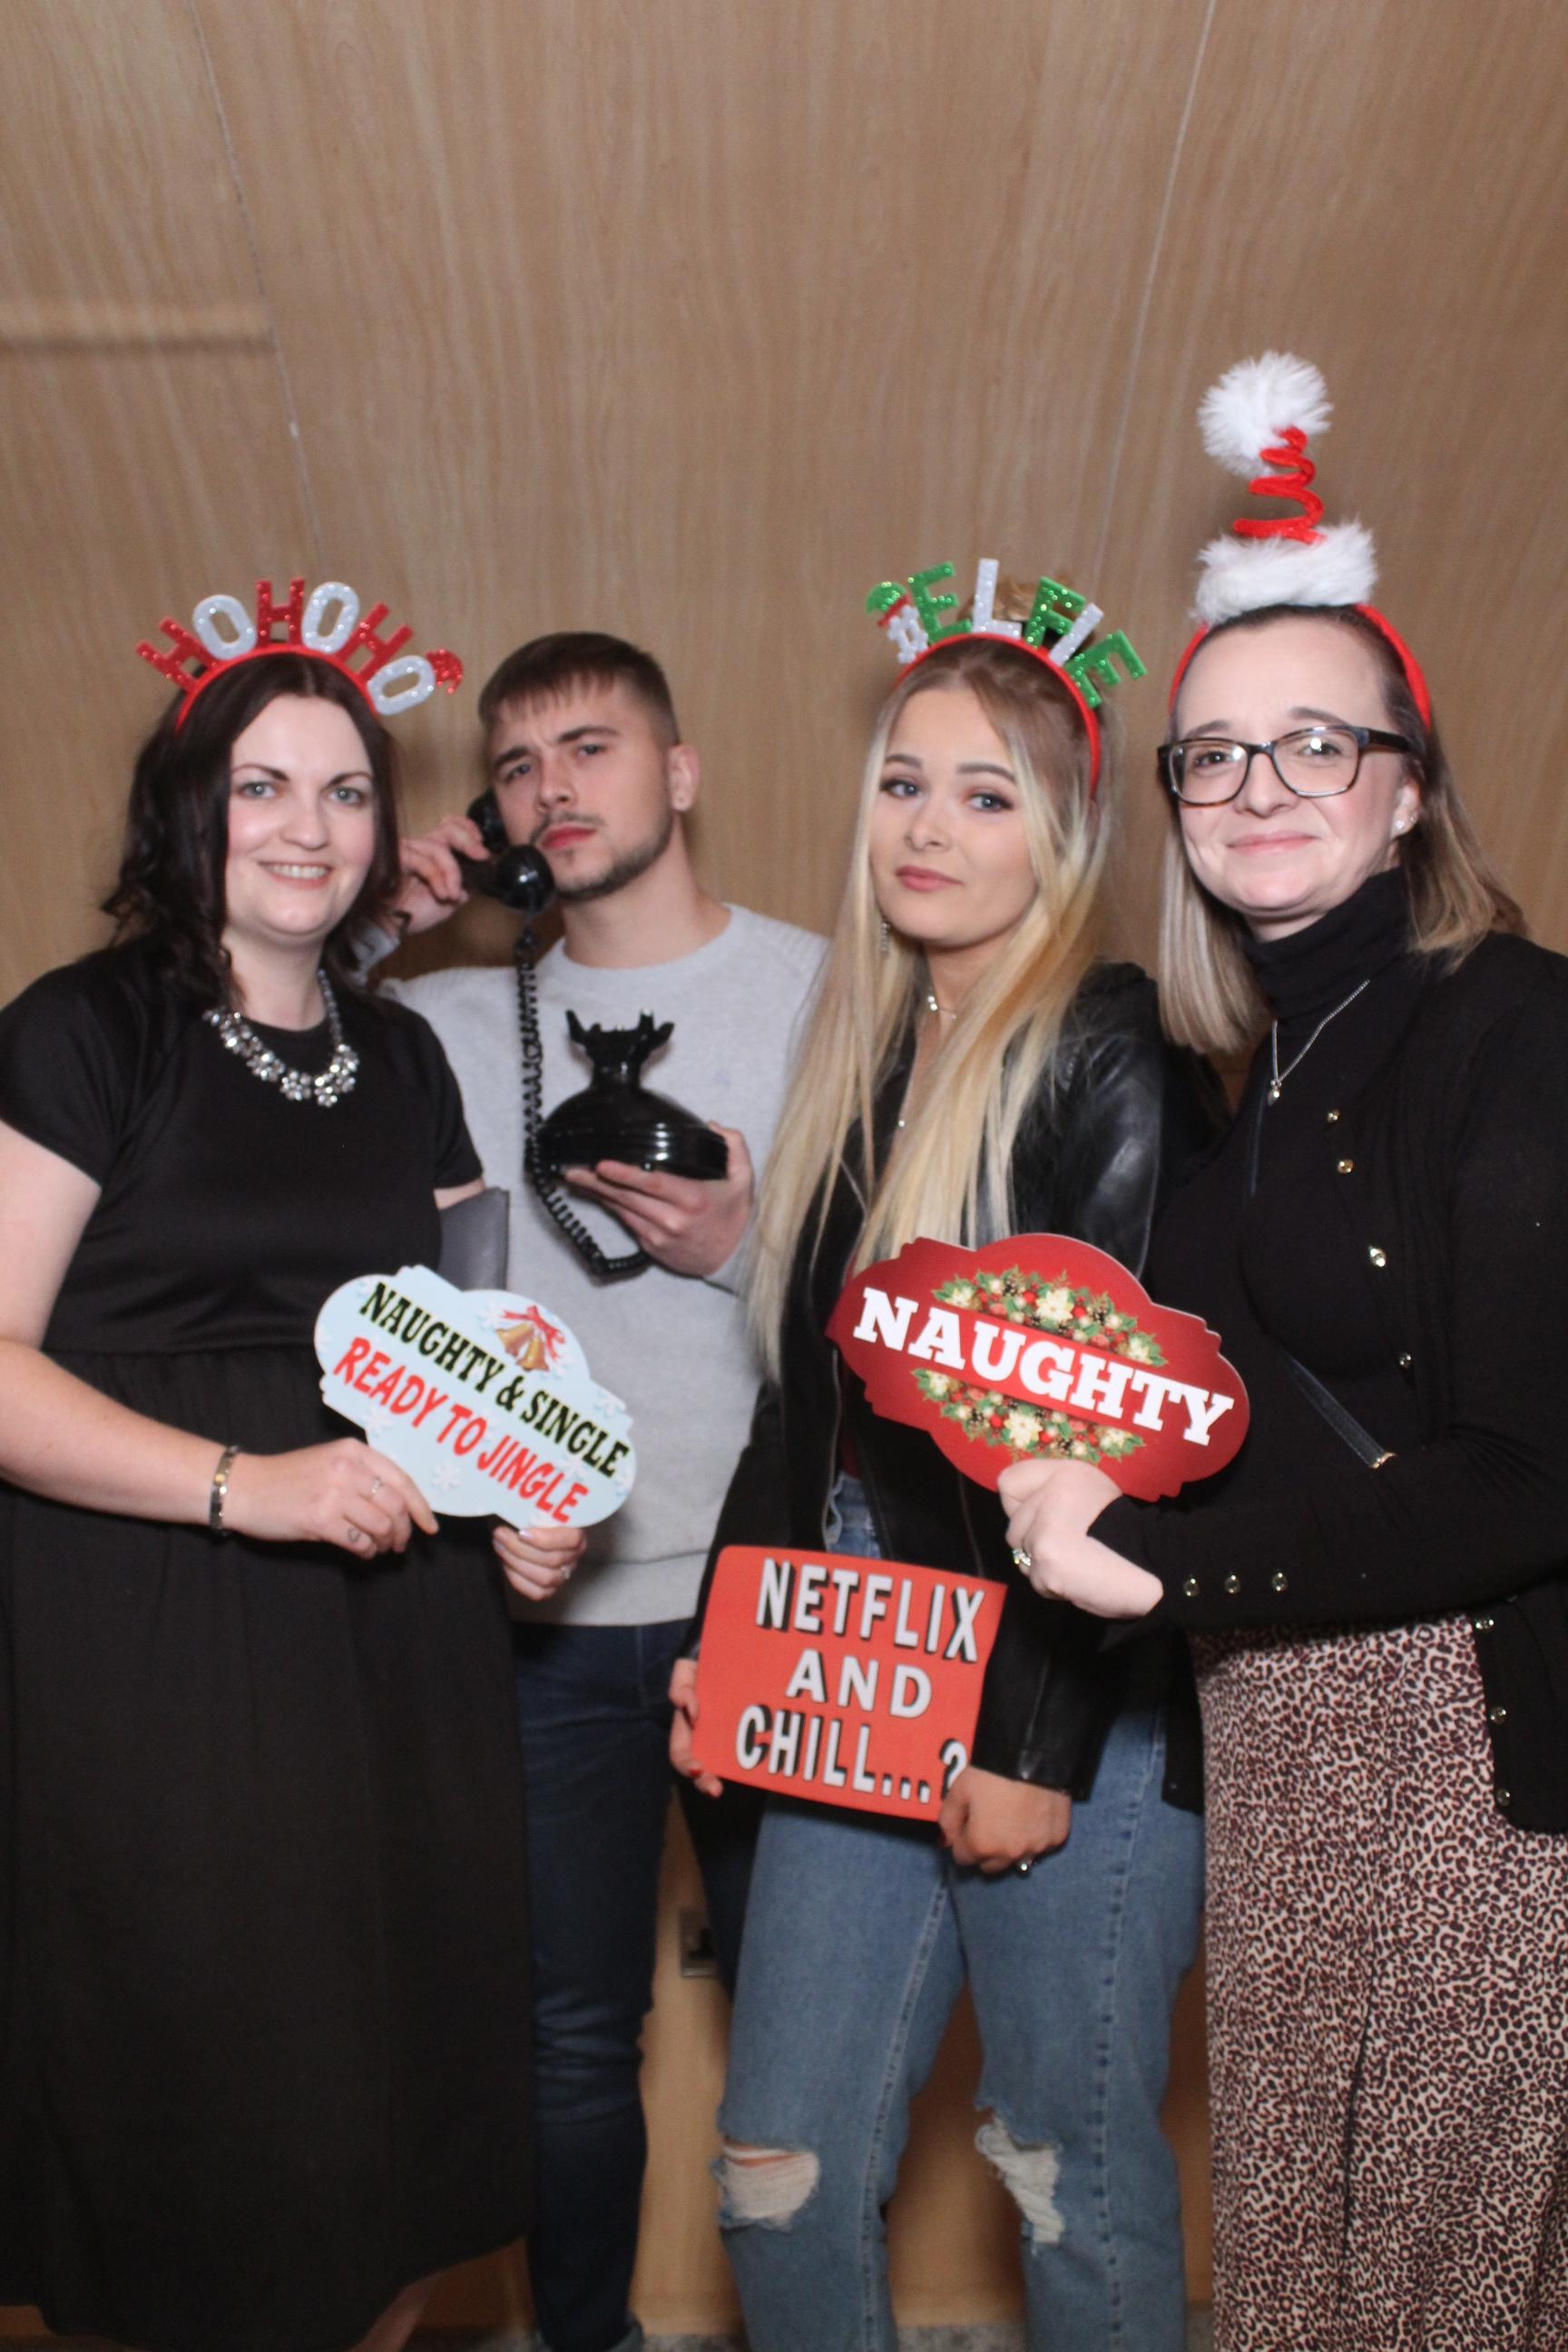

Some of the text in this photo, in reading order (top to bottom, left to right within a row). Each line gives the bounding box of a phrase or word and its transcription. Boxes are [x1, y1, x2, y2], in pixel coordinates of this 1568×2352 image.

[333, 1336, 588, 1524] READY TO JINGLE
[359, 1281, 630, 1478] NAUGHTY & SINGLE
[853, 1287, 1235, 1447] NAUGHTY
[755, 1557, 985, 1662] NETFLIX
[785, 1648, 933, 1720] AND
